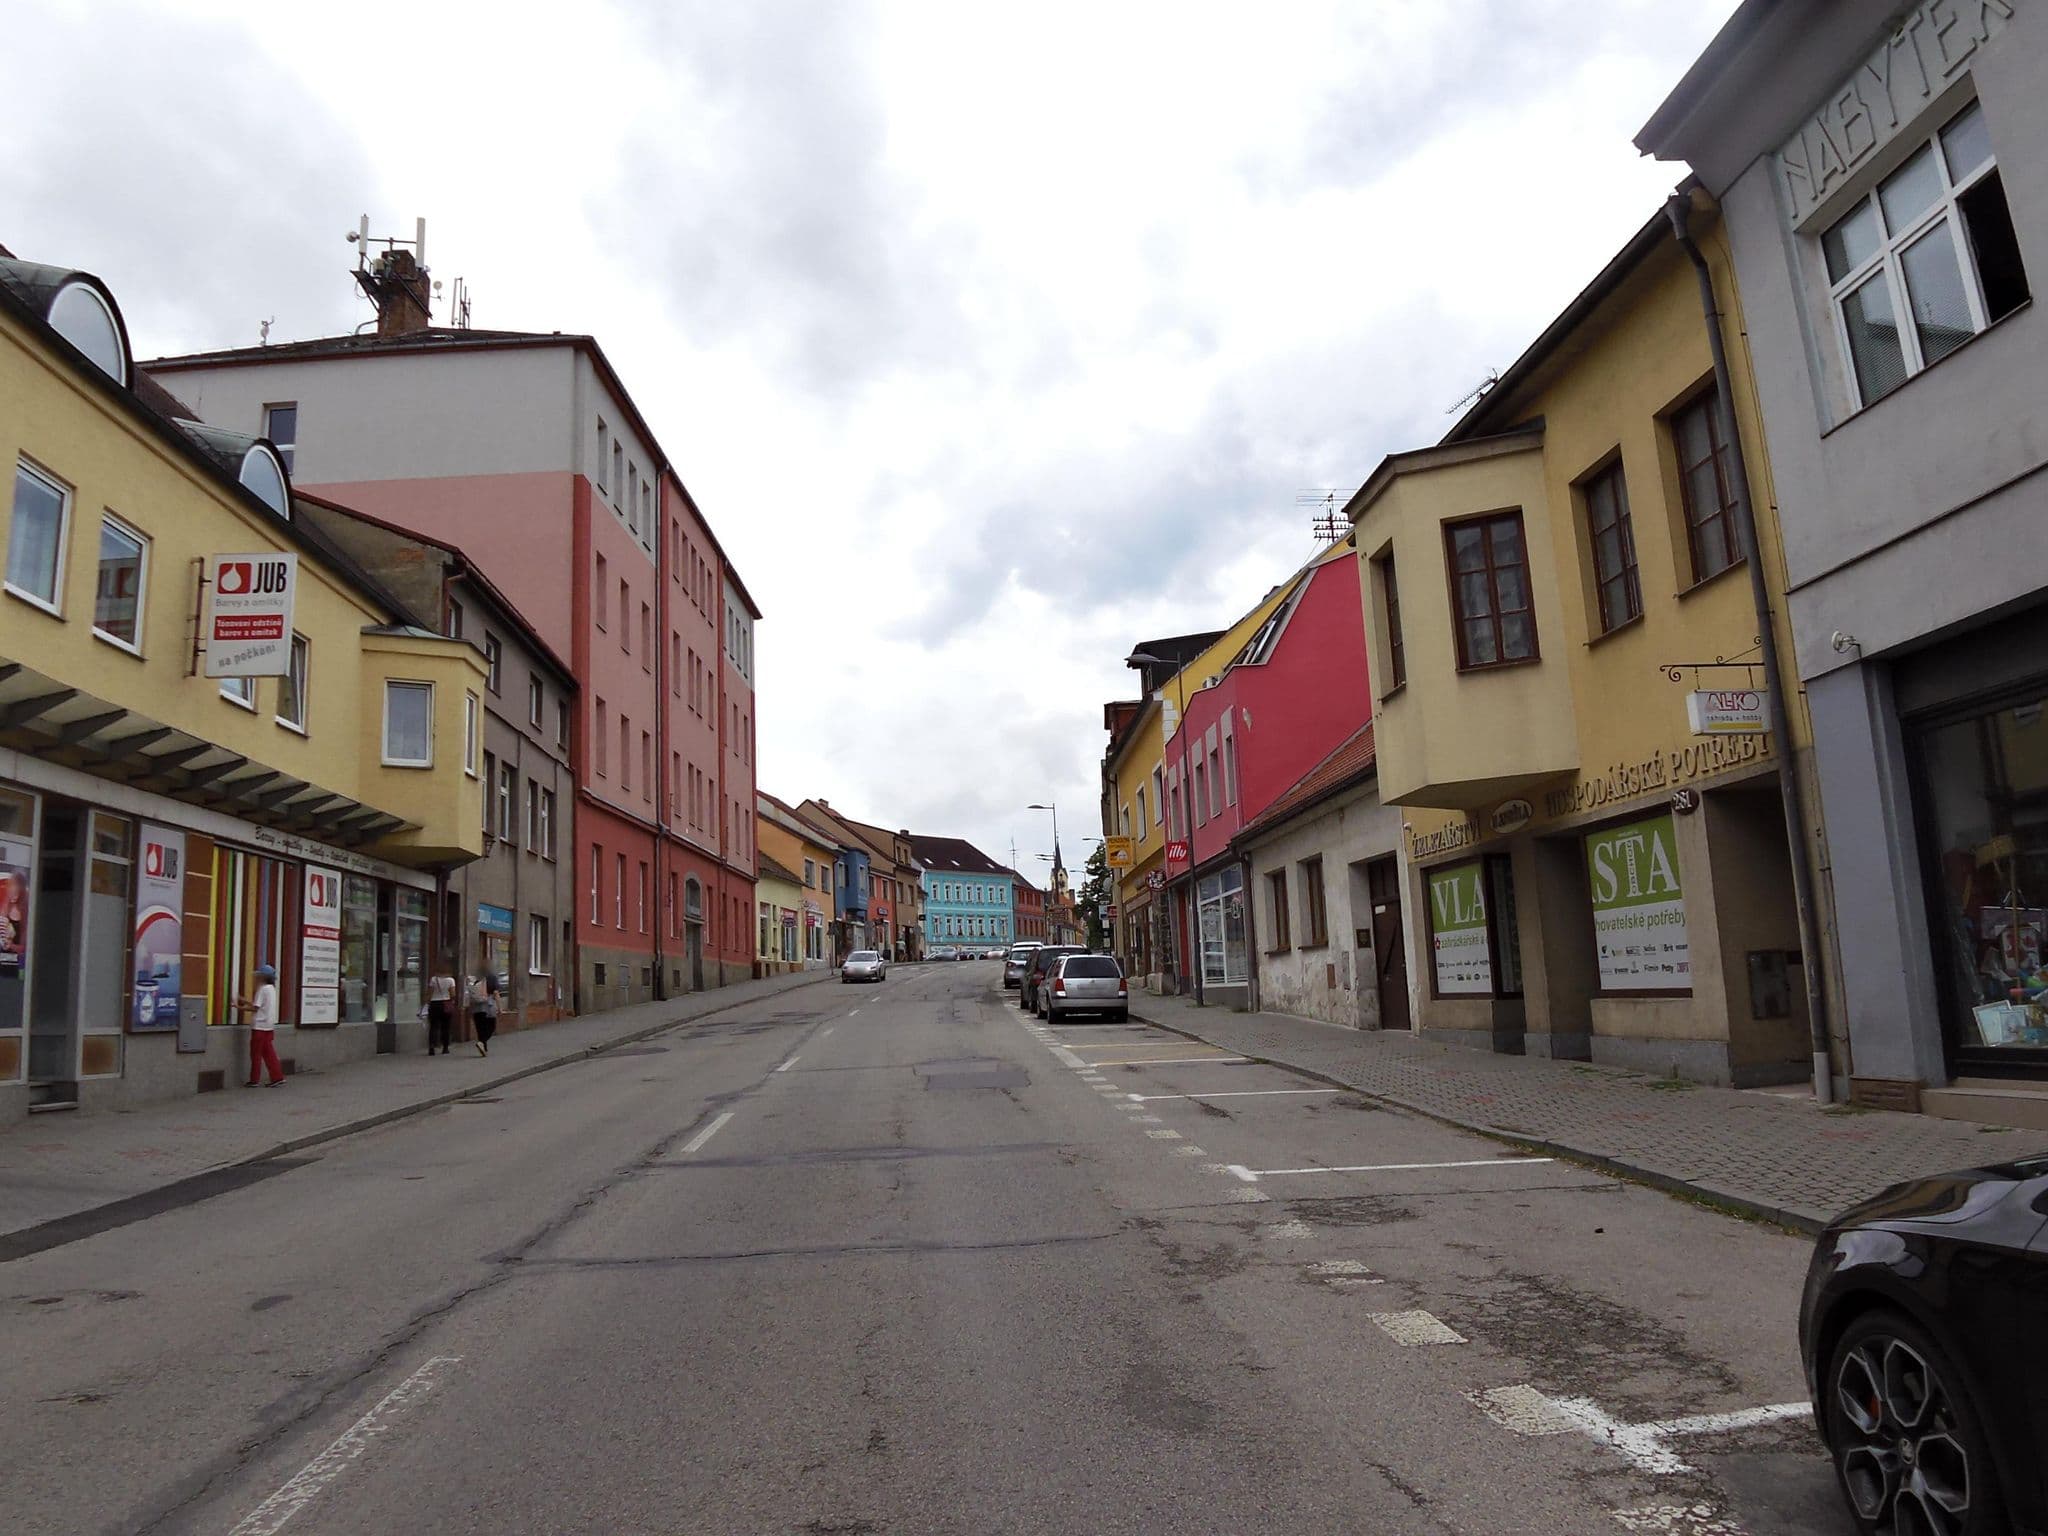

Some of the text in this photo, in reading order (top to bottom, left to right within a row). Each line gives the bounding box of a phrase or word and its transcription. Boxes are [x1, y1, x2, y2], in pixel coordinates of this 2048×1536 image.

[252, 562, 287, 593] JUB
[1168, 845, 1187, 860] illy
[1432, 873, 1486, 927] VLA
[1646, 908, 1686, 930] potřeby
